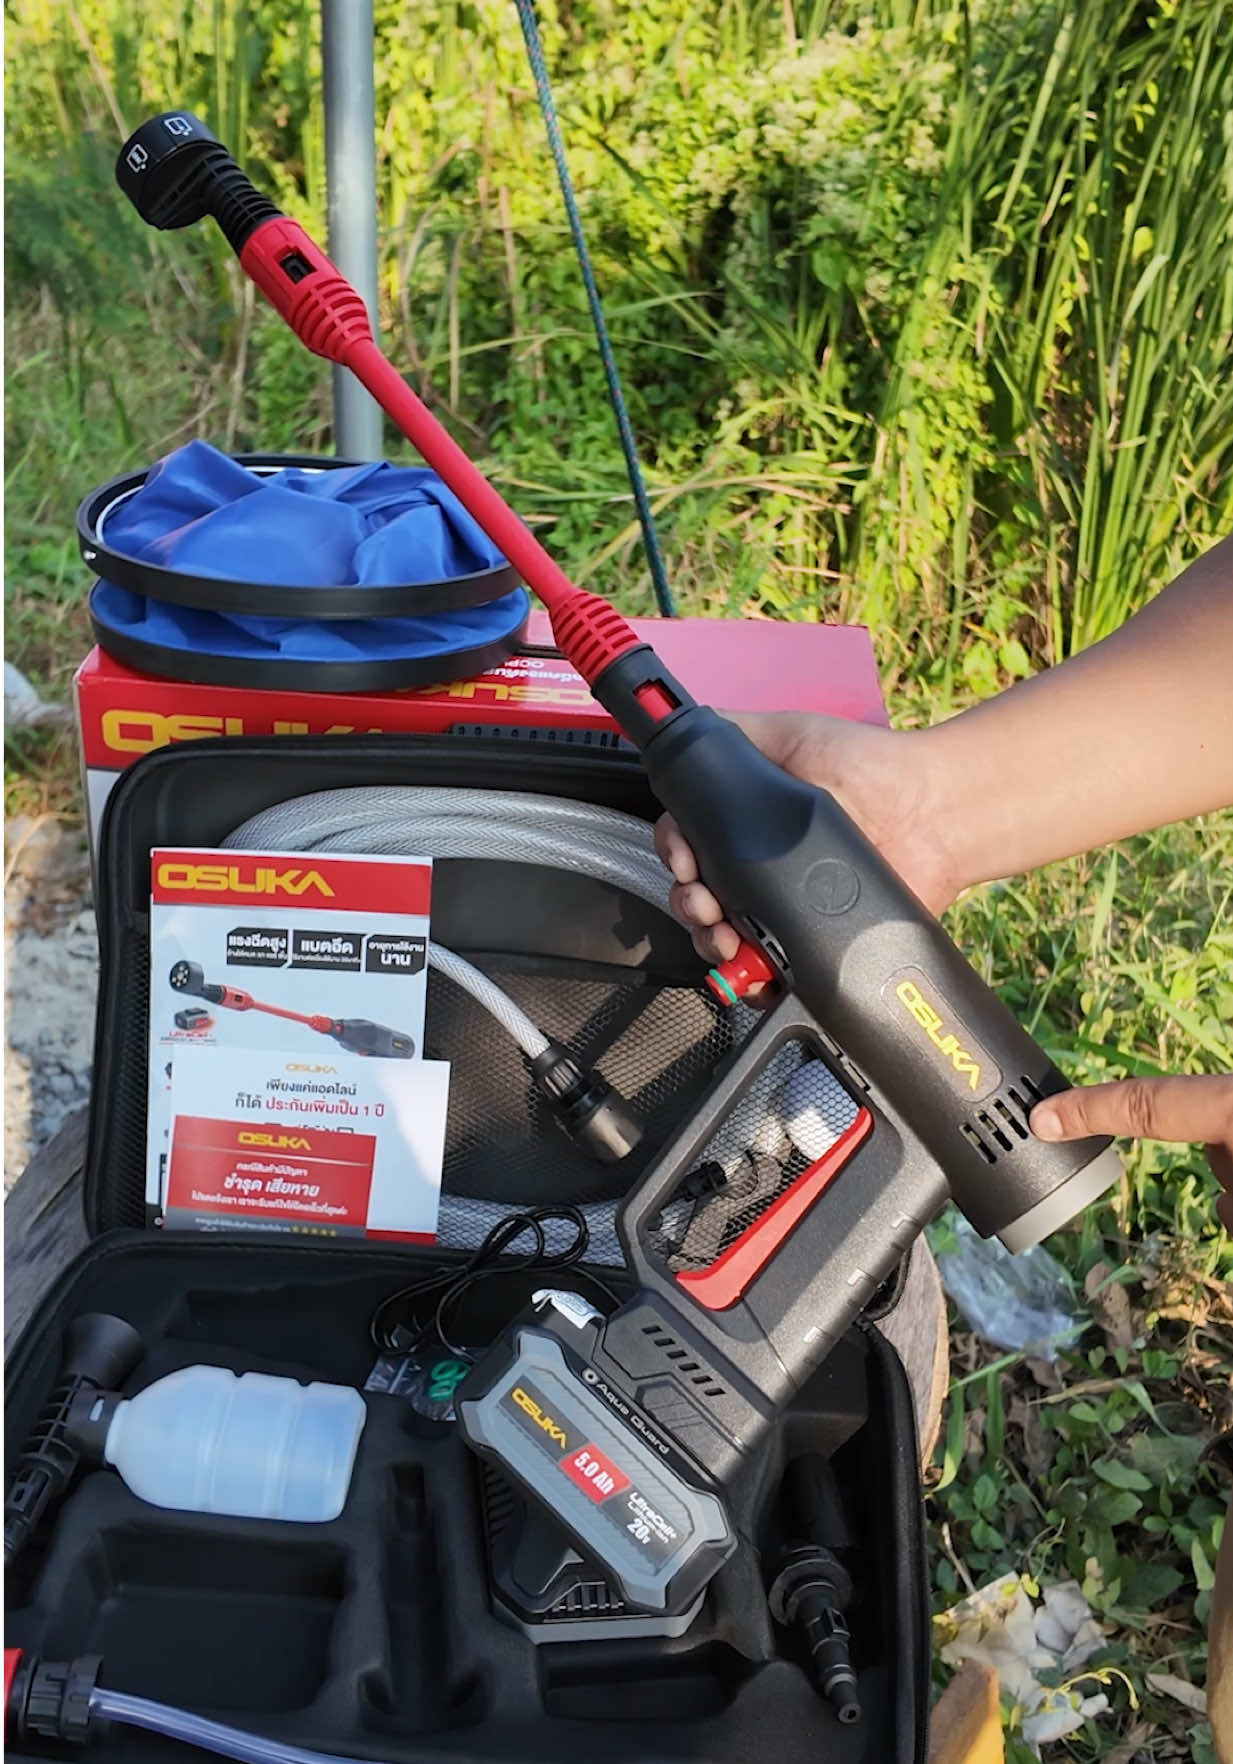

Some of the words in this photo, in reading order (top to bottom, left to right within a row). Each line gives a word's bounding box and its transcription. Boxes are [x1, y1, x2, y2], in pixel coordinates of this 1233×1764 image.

[157, 863, 336, 897] OSUKA
[228, 933, 287, 954] แรงฉีดสูง
[301, 936, 353, 954] แบตอึด
[381, 953, 411, 966] นาน
[897, 981, 980, 1091] OSUKA
[285, 1062, 338, 1075] OSUKA
[266, 1078, 358, 1097] เพียงแค่แอดไลน์
[235, 1092, 262, 1109] ก็ได้
[265, 1095, 359, 1117] ประกันเพิ่มเป็น
[363, 1105, 370, 1116] 1
[374, 1103, 385, 1118] ปี
[238, 1131, 312, 1151] OSUKA
[224, 1173, 263, 1196] ชำรุด
[265, 1177, 321, 1198] เสียหาย
[512, 1388, 566, 1449] OSUKA
[596, 1384, 629, 1415] Aqua
[630, 1415, 670, 1454] Guard
[574, 1451, 600, 1478] 5.0
[592, 1472, 615, 1495] Ah
